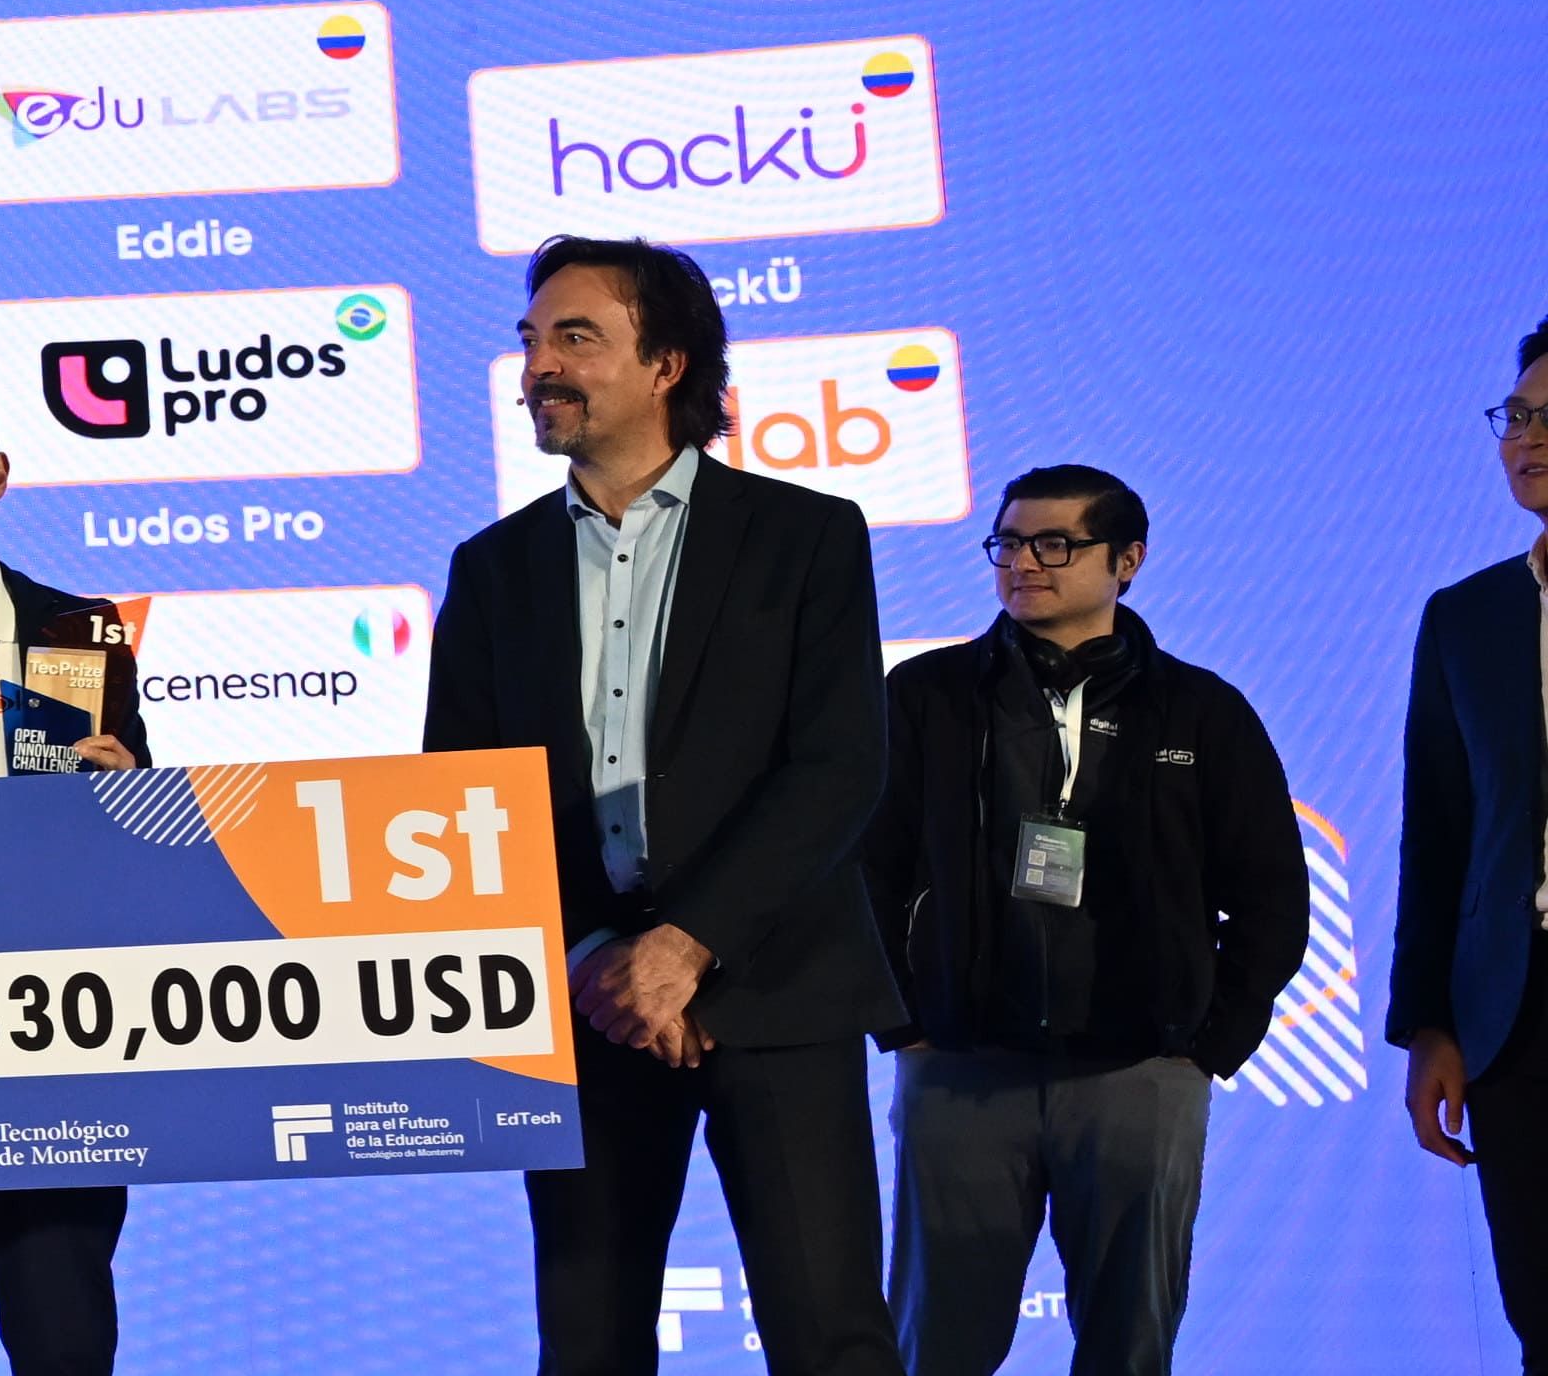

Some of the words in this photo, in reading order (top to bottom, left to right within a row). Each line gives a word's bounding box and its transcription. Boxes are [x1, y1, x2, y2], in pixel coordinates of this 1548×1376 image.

[160, 87, 351, 126] LABS
[116, 219, 253, 261] Eddie
[709, 257, 802, 308] ckÜ
[160, 333, 347, 383] Ludos
[163, 387, 268, 437] pro
[83, 508, 230, 547] Ludos
[242, 505, 325, 541] Pro
[89, 615, 137, 645] 1st
[29, 659, 103, 678] TecPrize
[68, 678, 102, 690] 2025
[140, 668, 357, 705] cenesnap
[14, 727, 46, 744] OPEN
[12, 755, 80, 774] CHALLENGE
[295, 778, 509, 904] 1st
[357, 953, 536, 1037] USD
[343, 1101, 409, 1116] Instituto
[496, 1111, 562, 1127] EdTech
[344, 1120, 380, 1134] para
[382, 1118, 396, 1130] el
[399, 1116, 450, 1130] Futuro
[32, 1140, 149, 1168] Monterrey
[346, 1135, 366, 1148] de
[368, 1134, 383, 1147] la
[385, 1132, 465, 1147] Educación
[348, 1149, 403, 1161] Tecnológico
[404, 1149, 416, 1158] de
[417, 1147, 465, 1159] Monterrey
